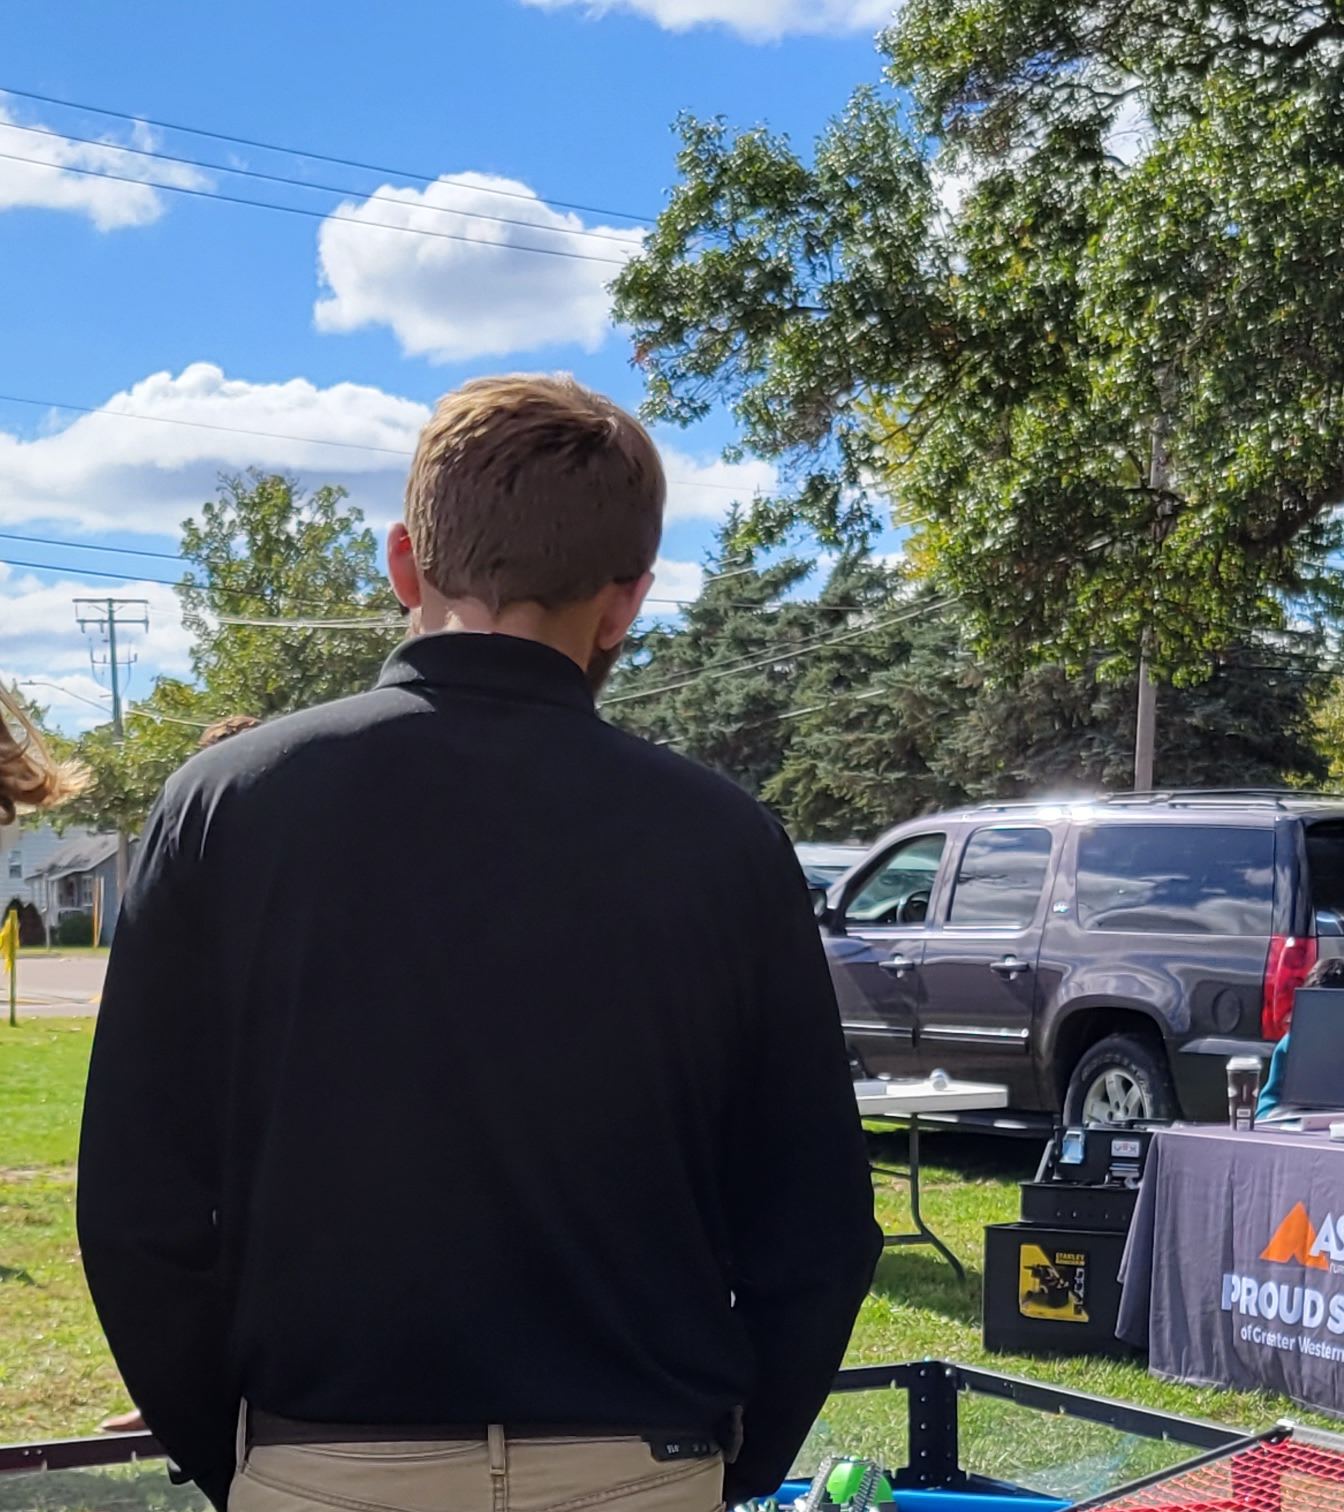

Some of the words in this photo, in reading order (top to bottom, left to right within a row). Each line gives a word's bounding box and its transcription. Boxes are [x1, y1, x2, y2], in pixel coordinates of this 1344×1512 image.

[1221, 1273, 1325, 1329] PROUD
[1240, 1326, 1252, 1342] of
[1253, 1328, 1297, 1352] Greater
